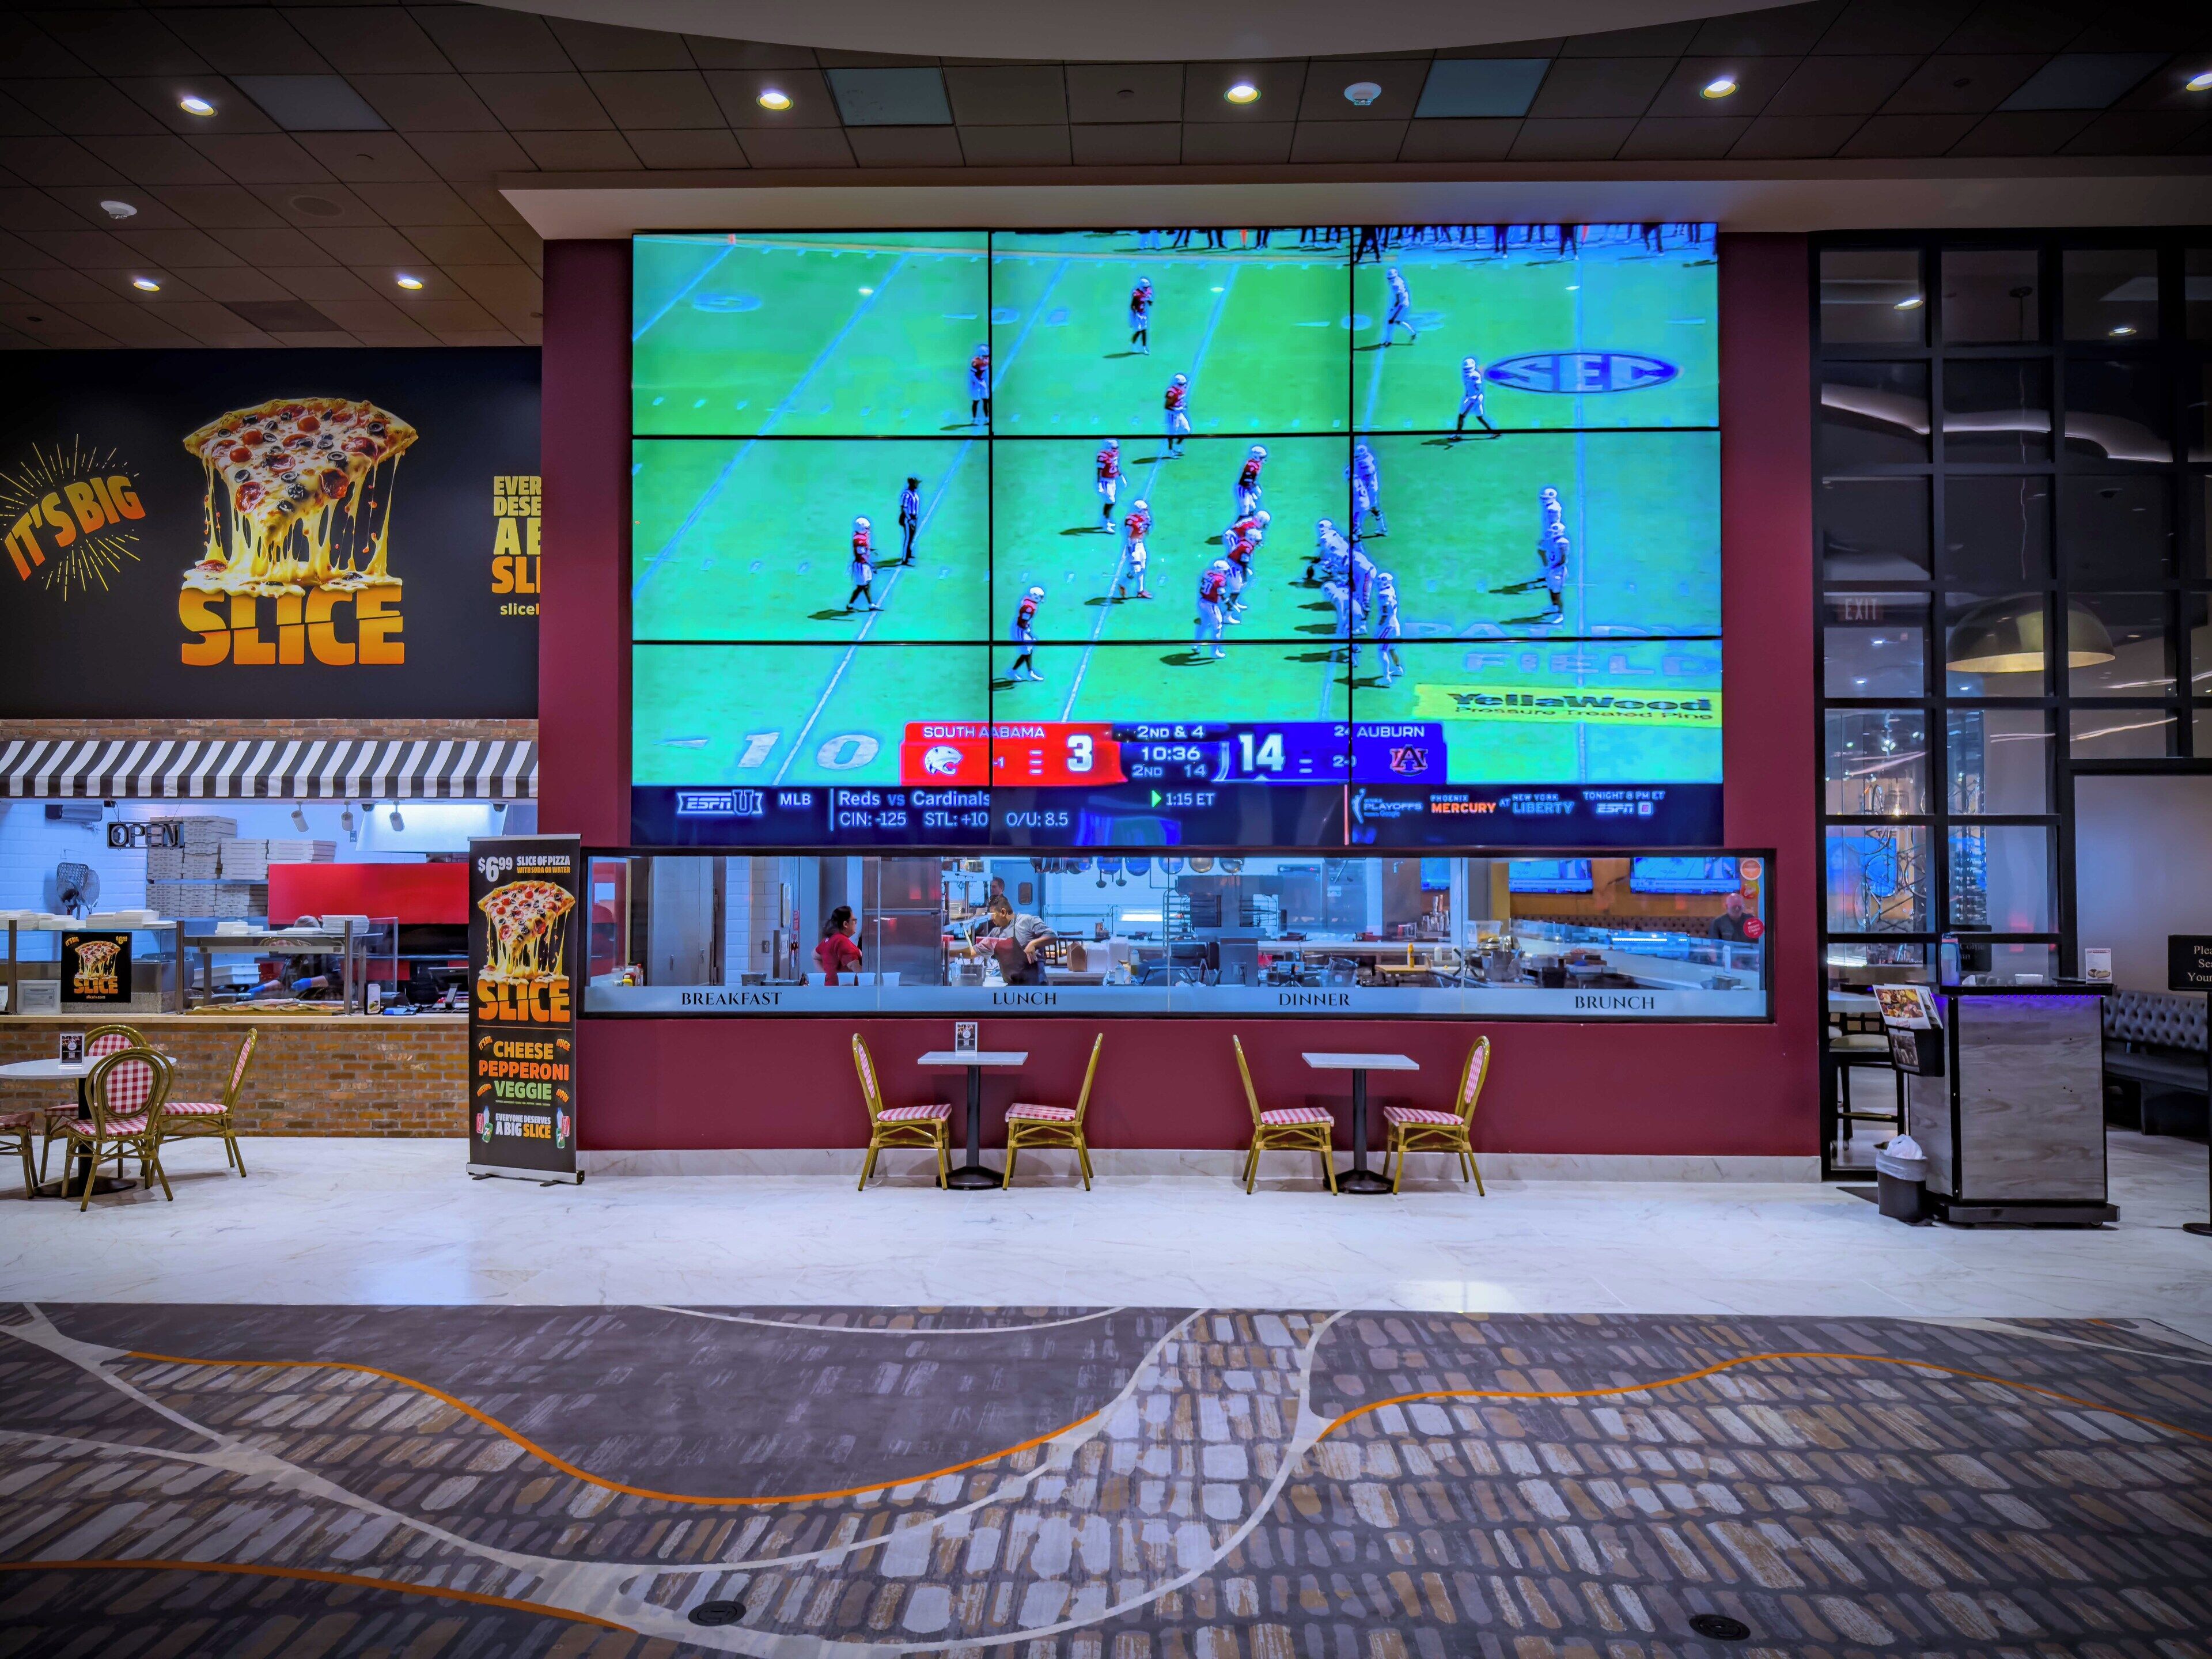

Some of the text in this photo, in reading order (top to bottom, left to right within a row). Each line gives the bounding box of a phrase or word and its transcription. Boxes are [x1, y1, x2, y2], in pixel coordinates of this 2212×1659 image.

[494, 496, 541, 516] DESE
[5, 476, 146, 581] IT'S BIG
[493, 517, 521, 555] A
[1845, 599, 1876, 620] EXIT
[179, 586, 405, 666] SLICE
[1447, 693, 1711, 711] YellaWood
[923, 726, 975, 738] SOUTH
[1138, 725, 1203, 738] 2ND & 4
[1357, 726, 1425, 738] AUBURN
[1067, 735, 1092, 772] 3
[1142, 747, 1200, 760] 10:36
[1237, 733, 1284, 771] 14
[1132, 764, 1207, 777] 2ND 14
[781, 793, 811, 806] MLB
[839, 790, 990, 805] Reds vs Cardinals
[1166, 793, 1215, 805] 1:15 ET
[1499, 798, 1510, 806] AT
[1584, 791, 1624, 800] TONIGHT
[1652, 791, 1665, 800] ET
[1431, 803, 1497, 813] MERCURY
[1513, 802, 1574, 814] LIBERTY
[1597, 804, 1633, 813] ESPN
[840, 812, 872, 826] CIN:
[876, 812, 906, 826] -125
[925, 812, 958, 827] STL:
[1006, 812, 1041, 826] O/U:
[1045, 812, 1068, 826] 8.5
[111, 824, 180, 847] OPEN
[517, 855, 570, 866] SLICE OF PIZZA
[2198, 959, 2212, 968] Se
[74, 978, 118, 994] SLICE
[477, 979, 570, 1022] SLICE
[682, 992, 782, 1005] BREAKFAST
[993, 992, 1057, 1005] LUNCH
[1279, 993, 1350, 1006] DINNER
[1575, 995, 1654, 1009] BRUNCH
[493, 1040, 554, 1060] CHEESE
[479, 1059, 569, 1081] PEPPERONI
[494, 1080, 552, 1100] VEGGIE
[495, 1112, 551, 1124] EVERYONE DESERVES
[495, 1121, 551, 1139] A BIG SLICE
